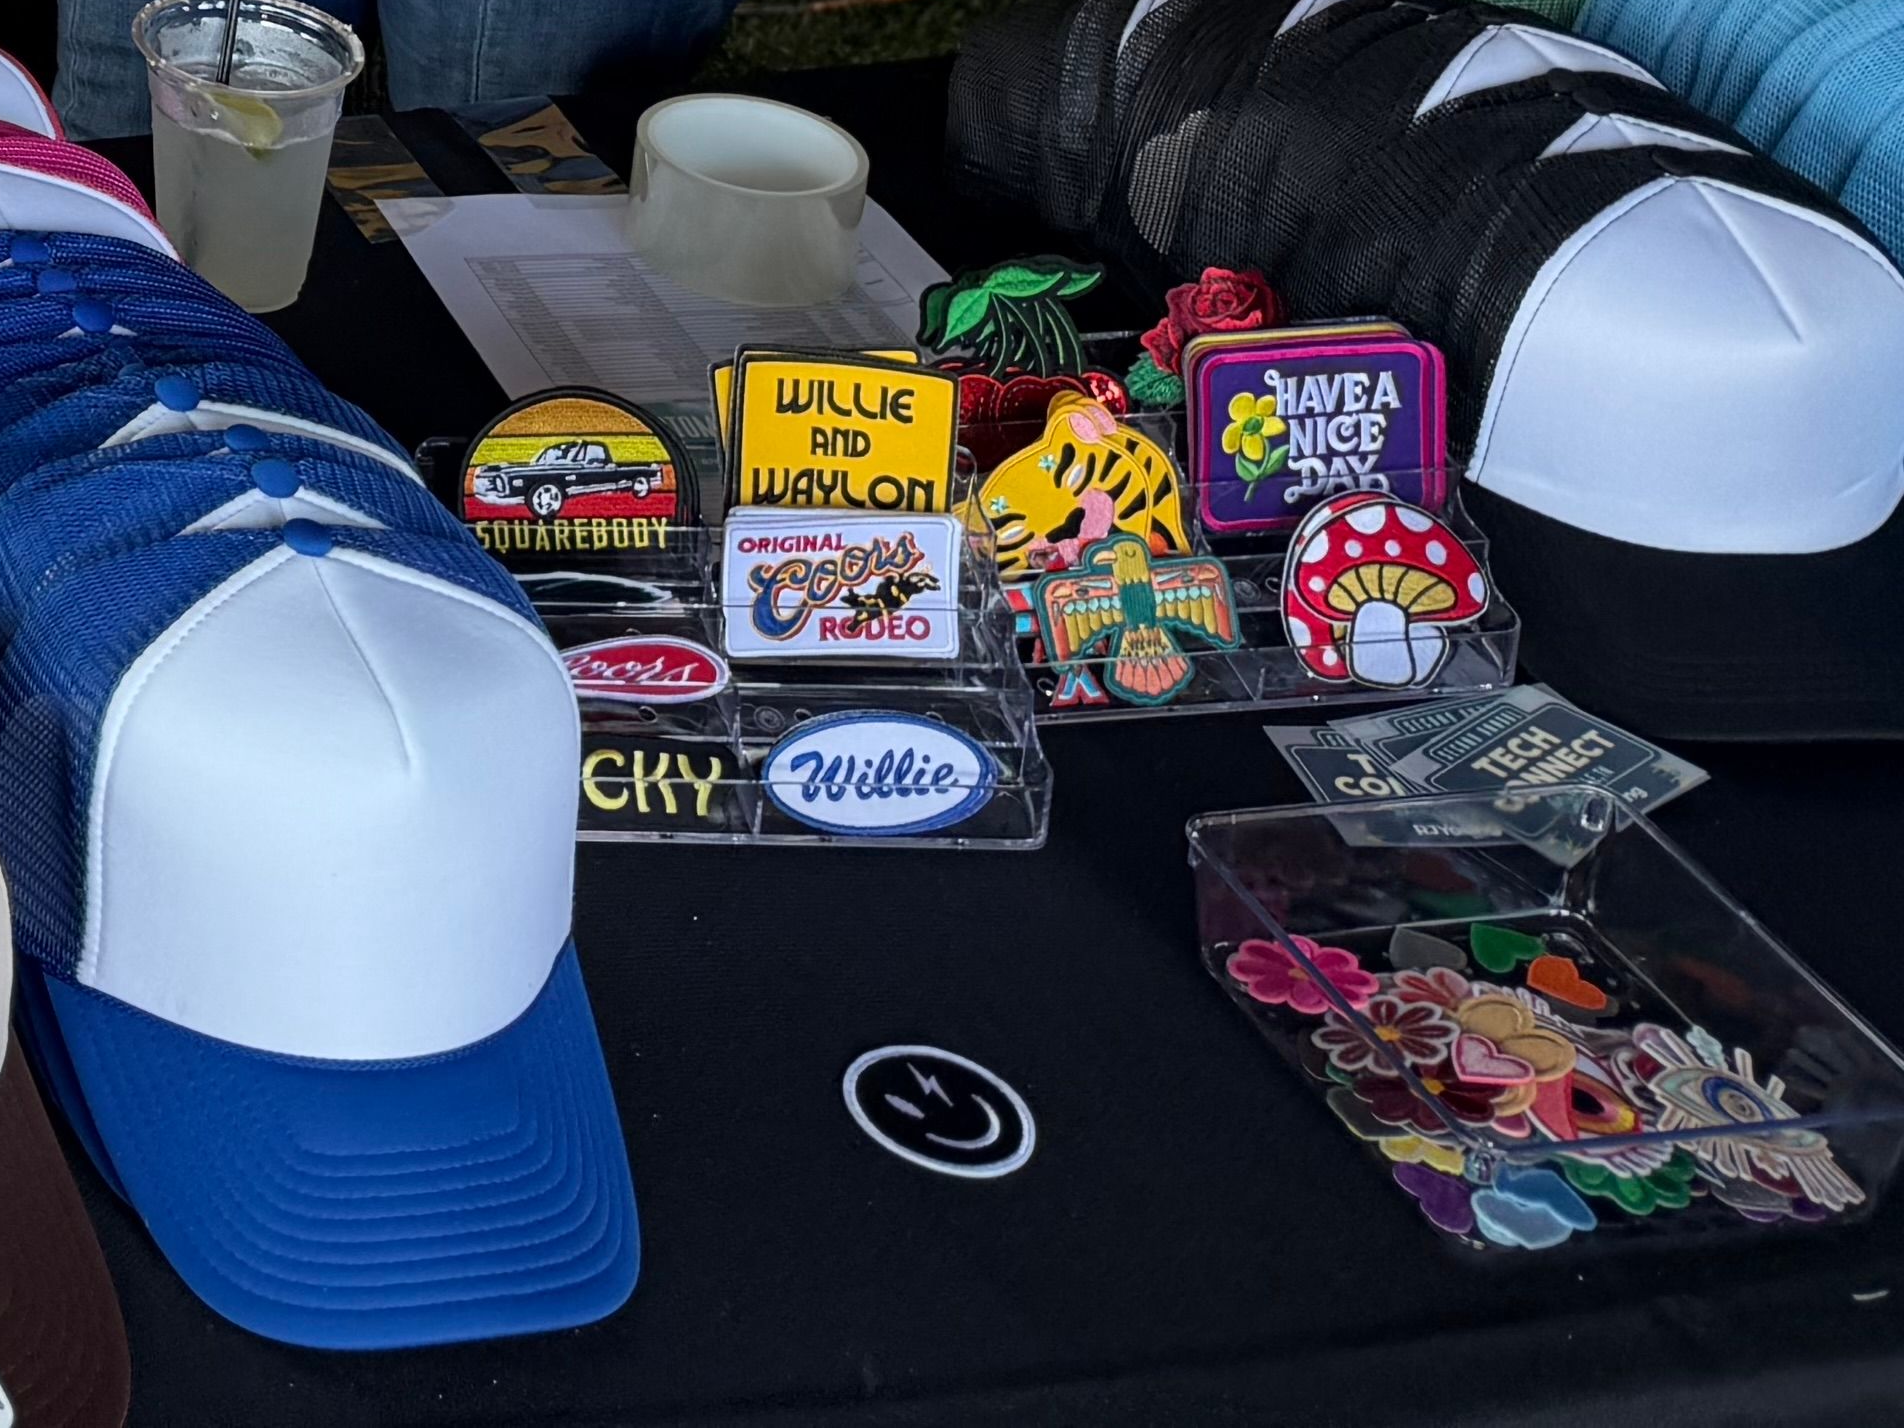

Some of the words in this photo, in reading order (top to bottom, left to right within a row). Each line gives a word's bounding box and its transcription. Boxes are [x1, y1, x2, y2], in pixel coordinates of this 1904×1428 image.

[775, 377, 916, 425] WILLIE
[1264, 369, 1370, 417] HAVE
[1371, 370, 1403, 410] A
[810, 426, 872, 458] AND
[1287, 412, 1388, 458] NICE
[752, 467, 936, 513] WAYLON
[1283, 454, 1391, 504] DAY
[475, 517, 668, 554] SQUAREBODY
[737, 532, 846, 554] ORIGINAL
[747, 530, 926, 641] Coors
[818, 615, 932, 642] RODEO
[789, 746, 961, 803] Willie
[1470, 725, 1563, 779] TECH
